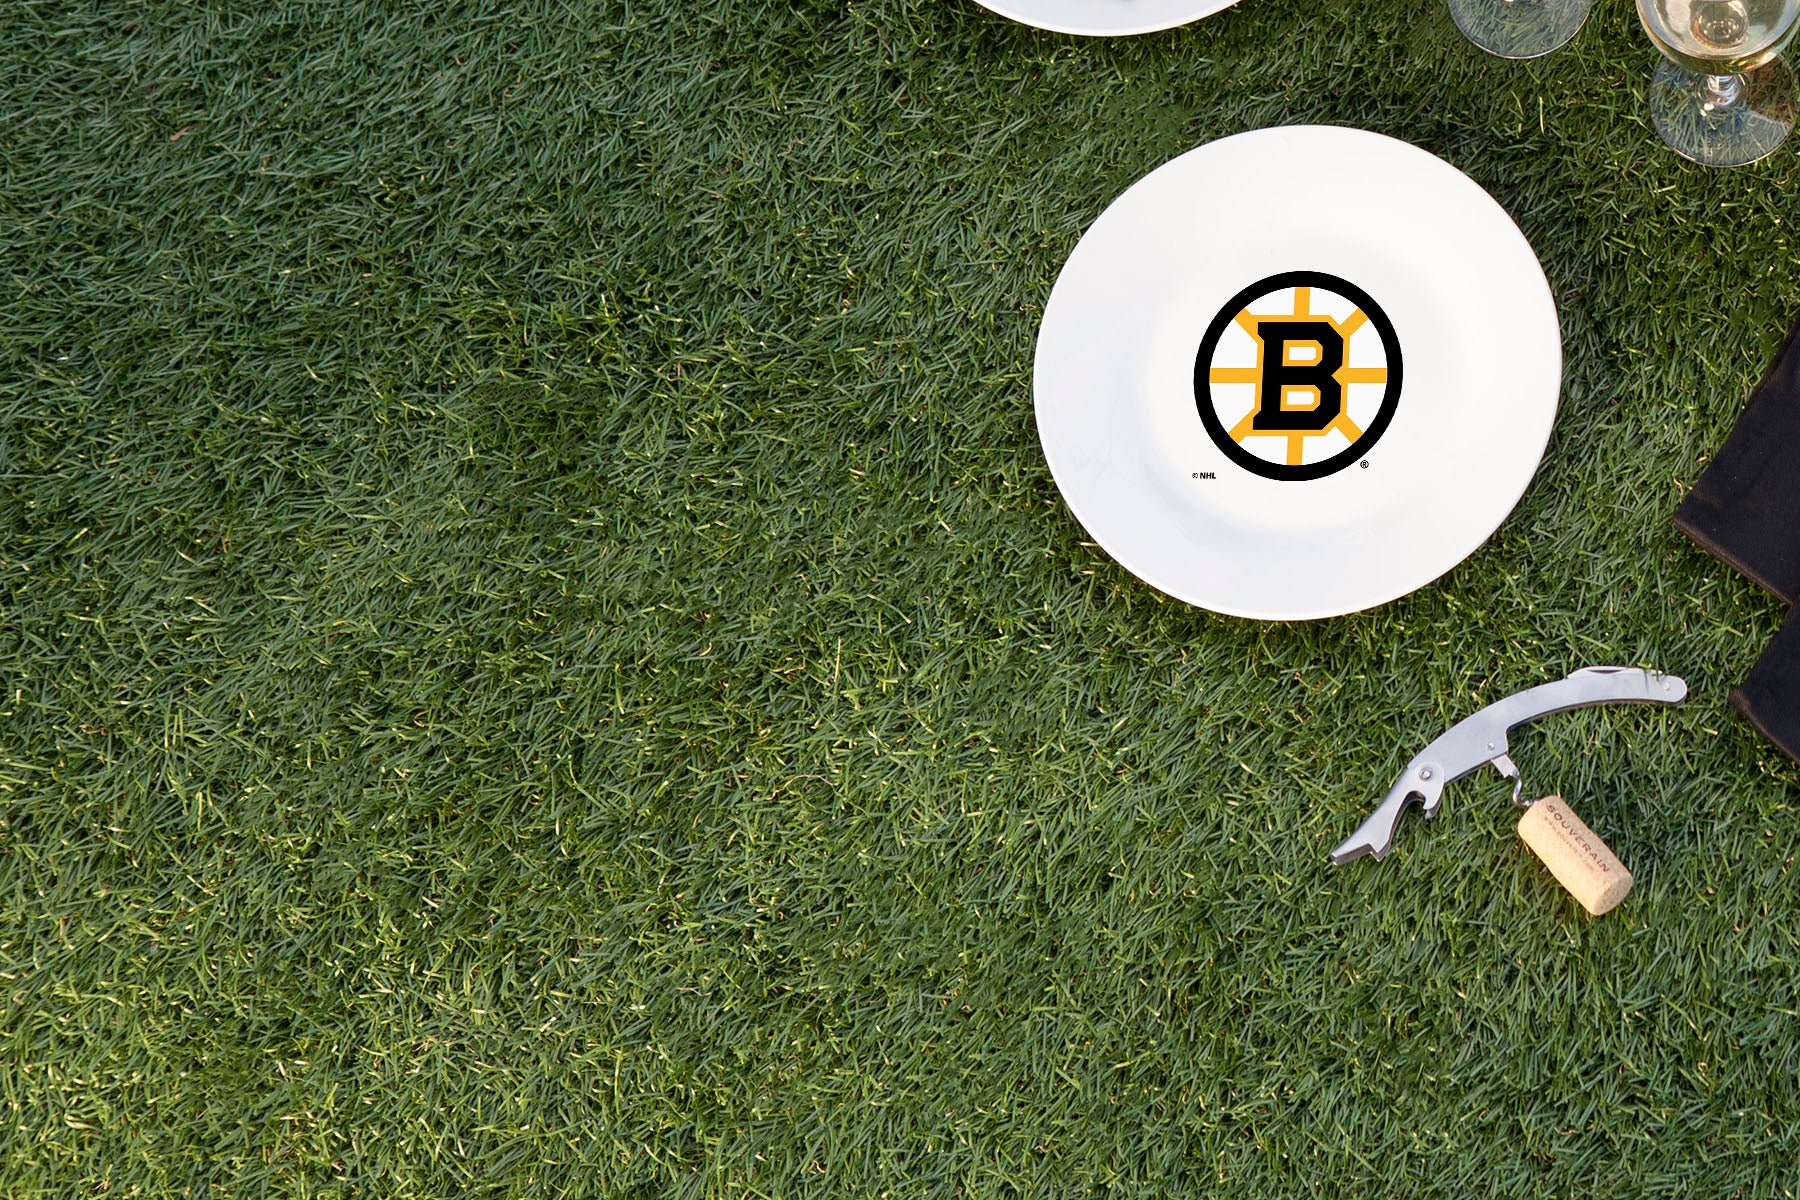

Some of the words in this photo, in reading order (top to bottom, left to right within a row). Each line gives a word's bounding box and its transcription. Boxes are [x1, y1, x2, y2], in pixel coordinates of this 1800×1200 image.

[1252, 321, 1345, 431] B
[1199, 471, 1217, 480] NHL
[1545, 803, 1610, 873] SOUVERAIN
